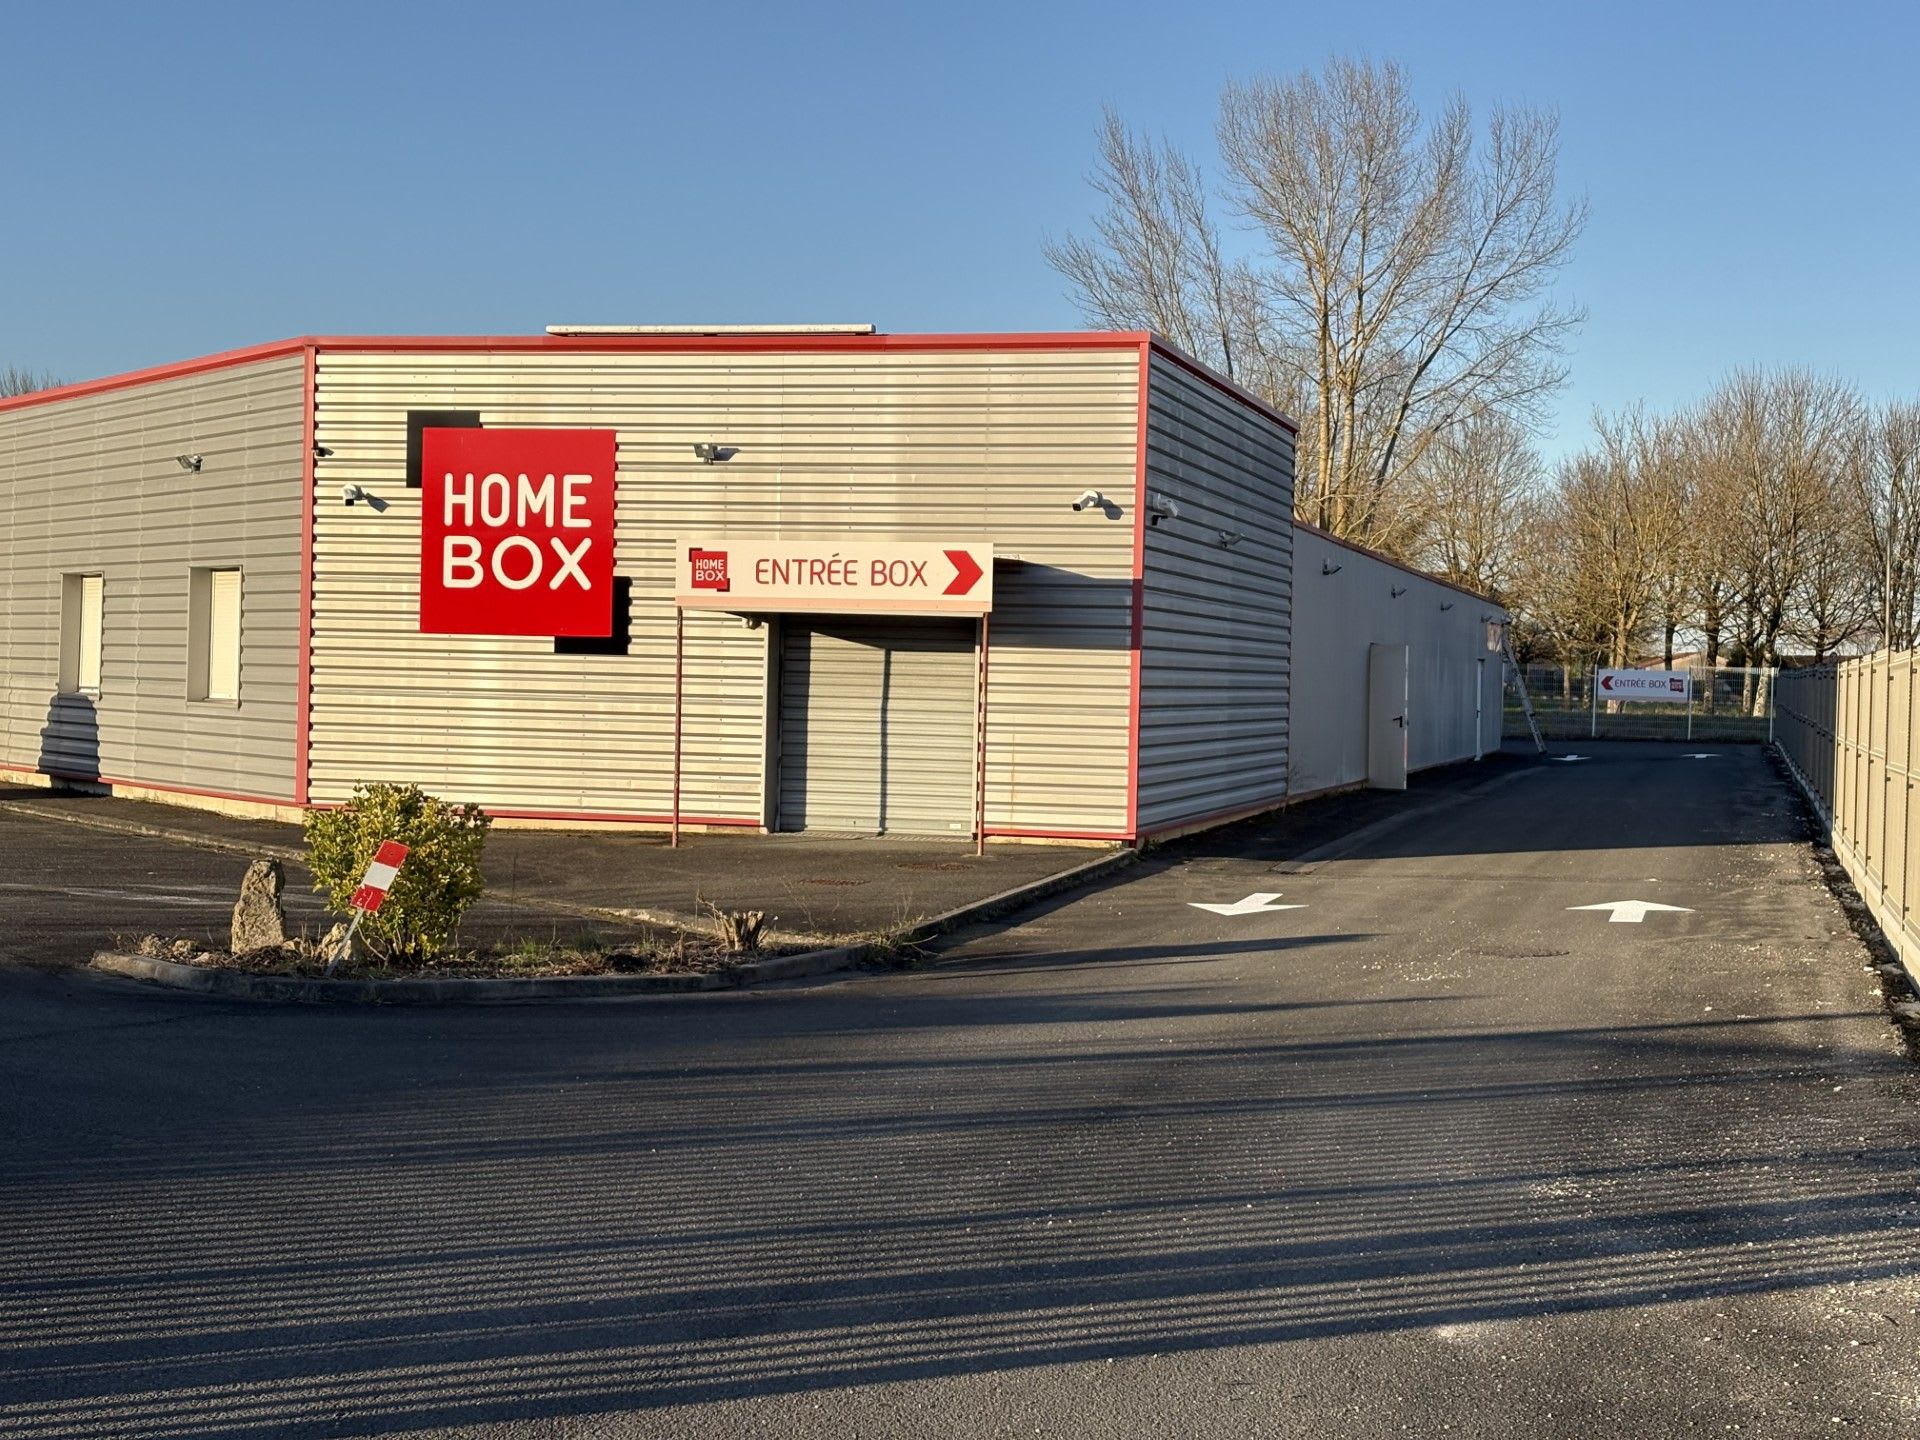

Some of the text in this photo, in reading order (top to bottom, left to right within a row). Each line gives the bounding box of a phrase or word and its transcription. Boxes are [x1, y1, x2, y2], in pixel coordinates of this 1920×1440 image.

[443, 472, 593, 528] HOME
[442, 535, 593, 591] BOX
[695, 559, 725, 570] HOME
[755, 553, 928, 587] ENTRÉE BOX
[695, 570, 725, 582] BOX
[1614, 678, 1646, 688] ENTRÉE
[1648, 680, 1666, 688] BOX
